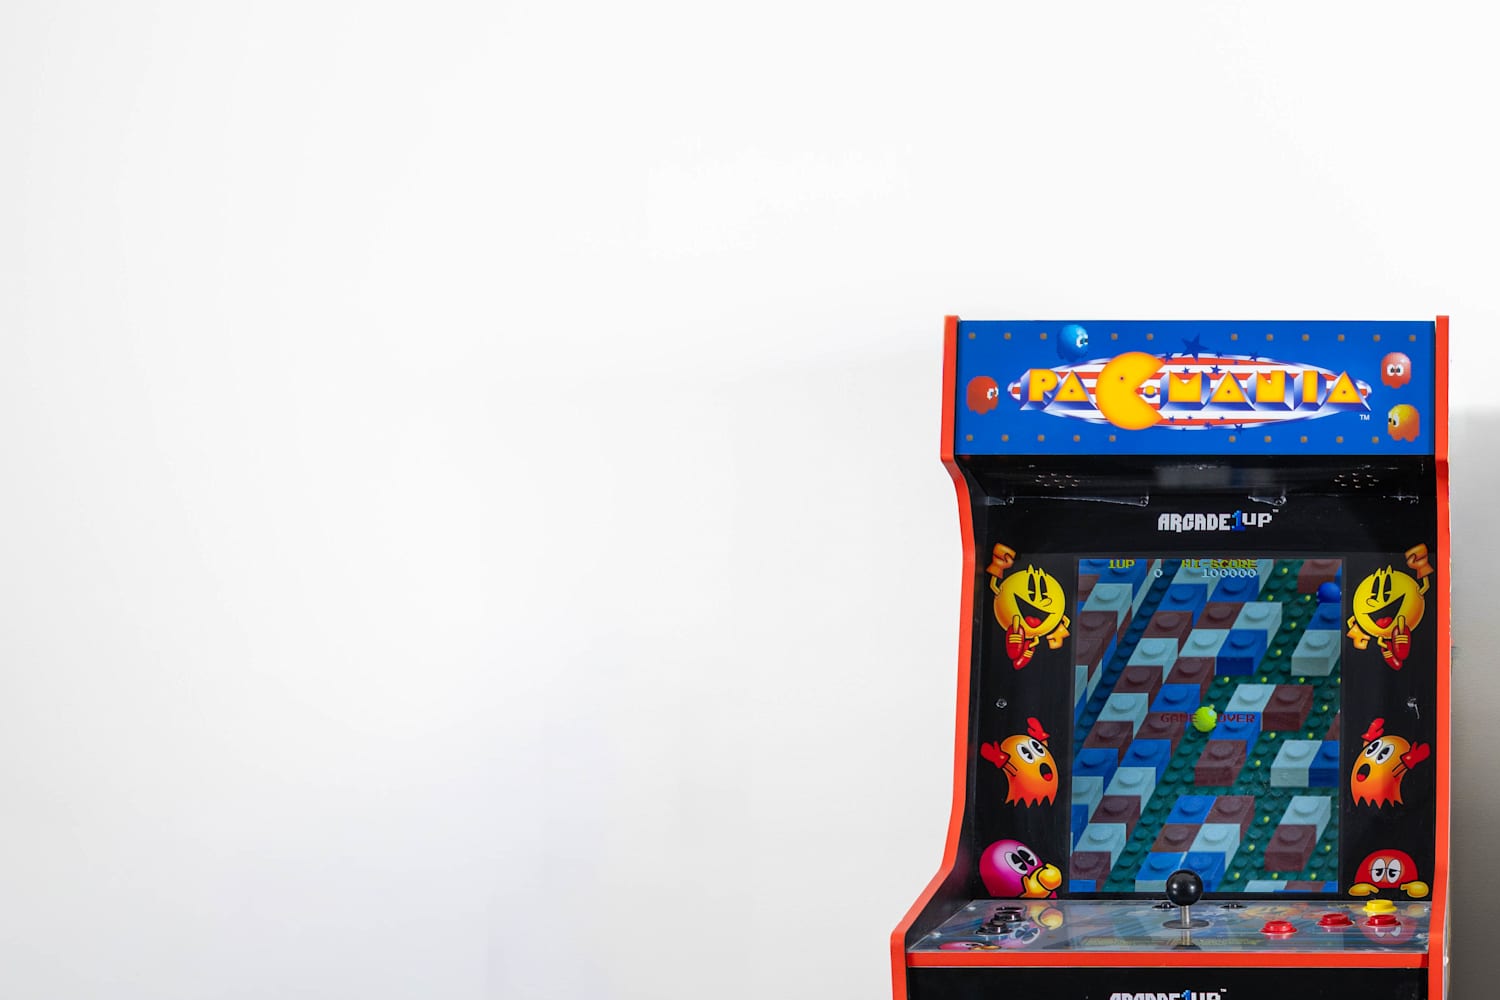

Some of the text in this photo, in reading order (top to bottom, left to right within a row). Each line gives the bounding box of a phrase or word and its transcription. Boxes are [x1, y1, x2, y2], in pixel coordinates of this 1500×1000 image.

[1108, 559, 1135, 569] 1UP
[1202, 569, 1257, 578] 100000
[1217, 713, 1255, 723] OVER
